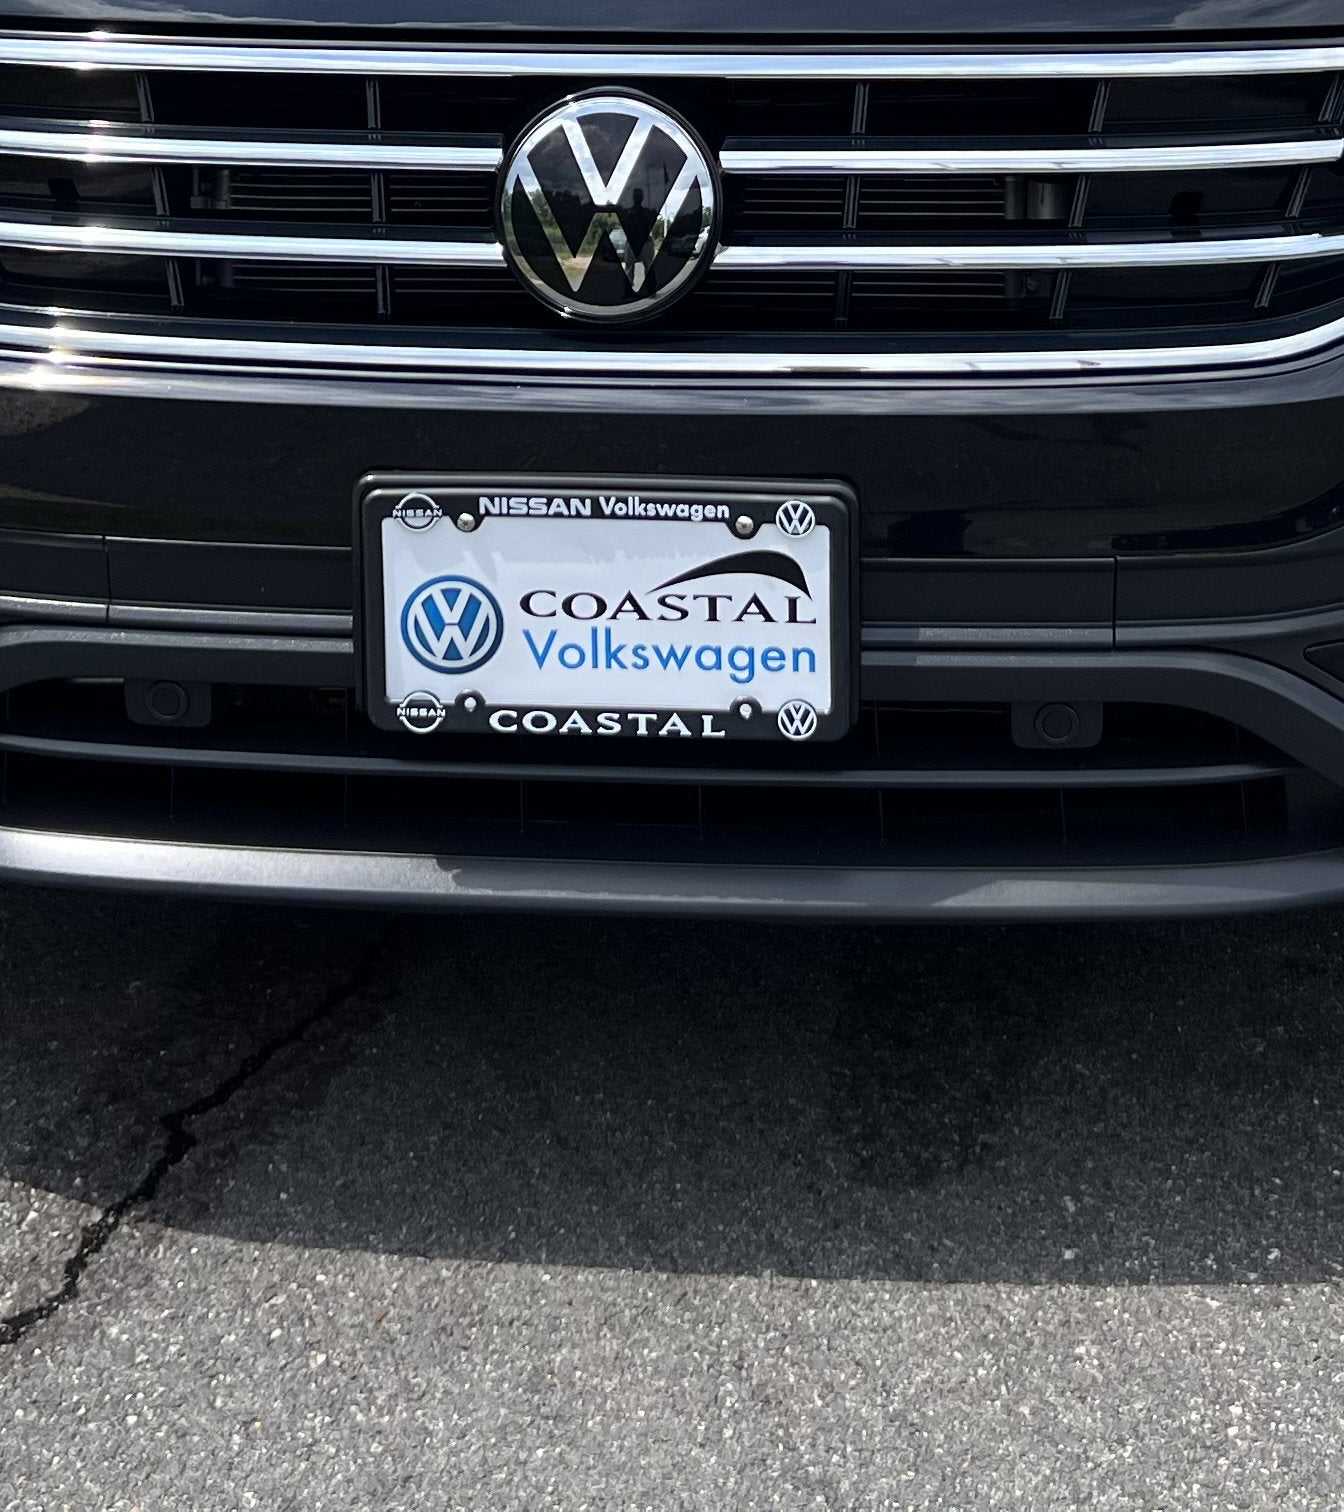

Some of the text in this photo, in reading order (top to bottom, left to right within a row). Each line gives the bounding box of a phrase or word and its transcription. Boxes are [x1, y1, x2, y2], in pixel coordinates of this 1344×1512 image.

[506, 100, 711, 308] VW
[392, 508, 443, 518] NISSAN
[479, 496, 730, 522] NISSAN Volkswagen
[776, 500, 815, 537] VW
[405, 579, 500, 670] VW
[519, 590, 817, 624] COASTAL
[522, 626, 816, 684] Volkswagen
[397, 707, 445, 717] NISSAN
[489, 709, 726, 738] COASTAL
[778, 701, 817, 739] VW
